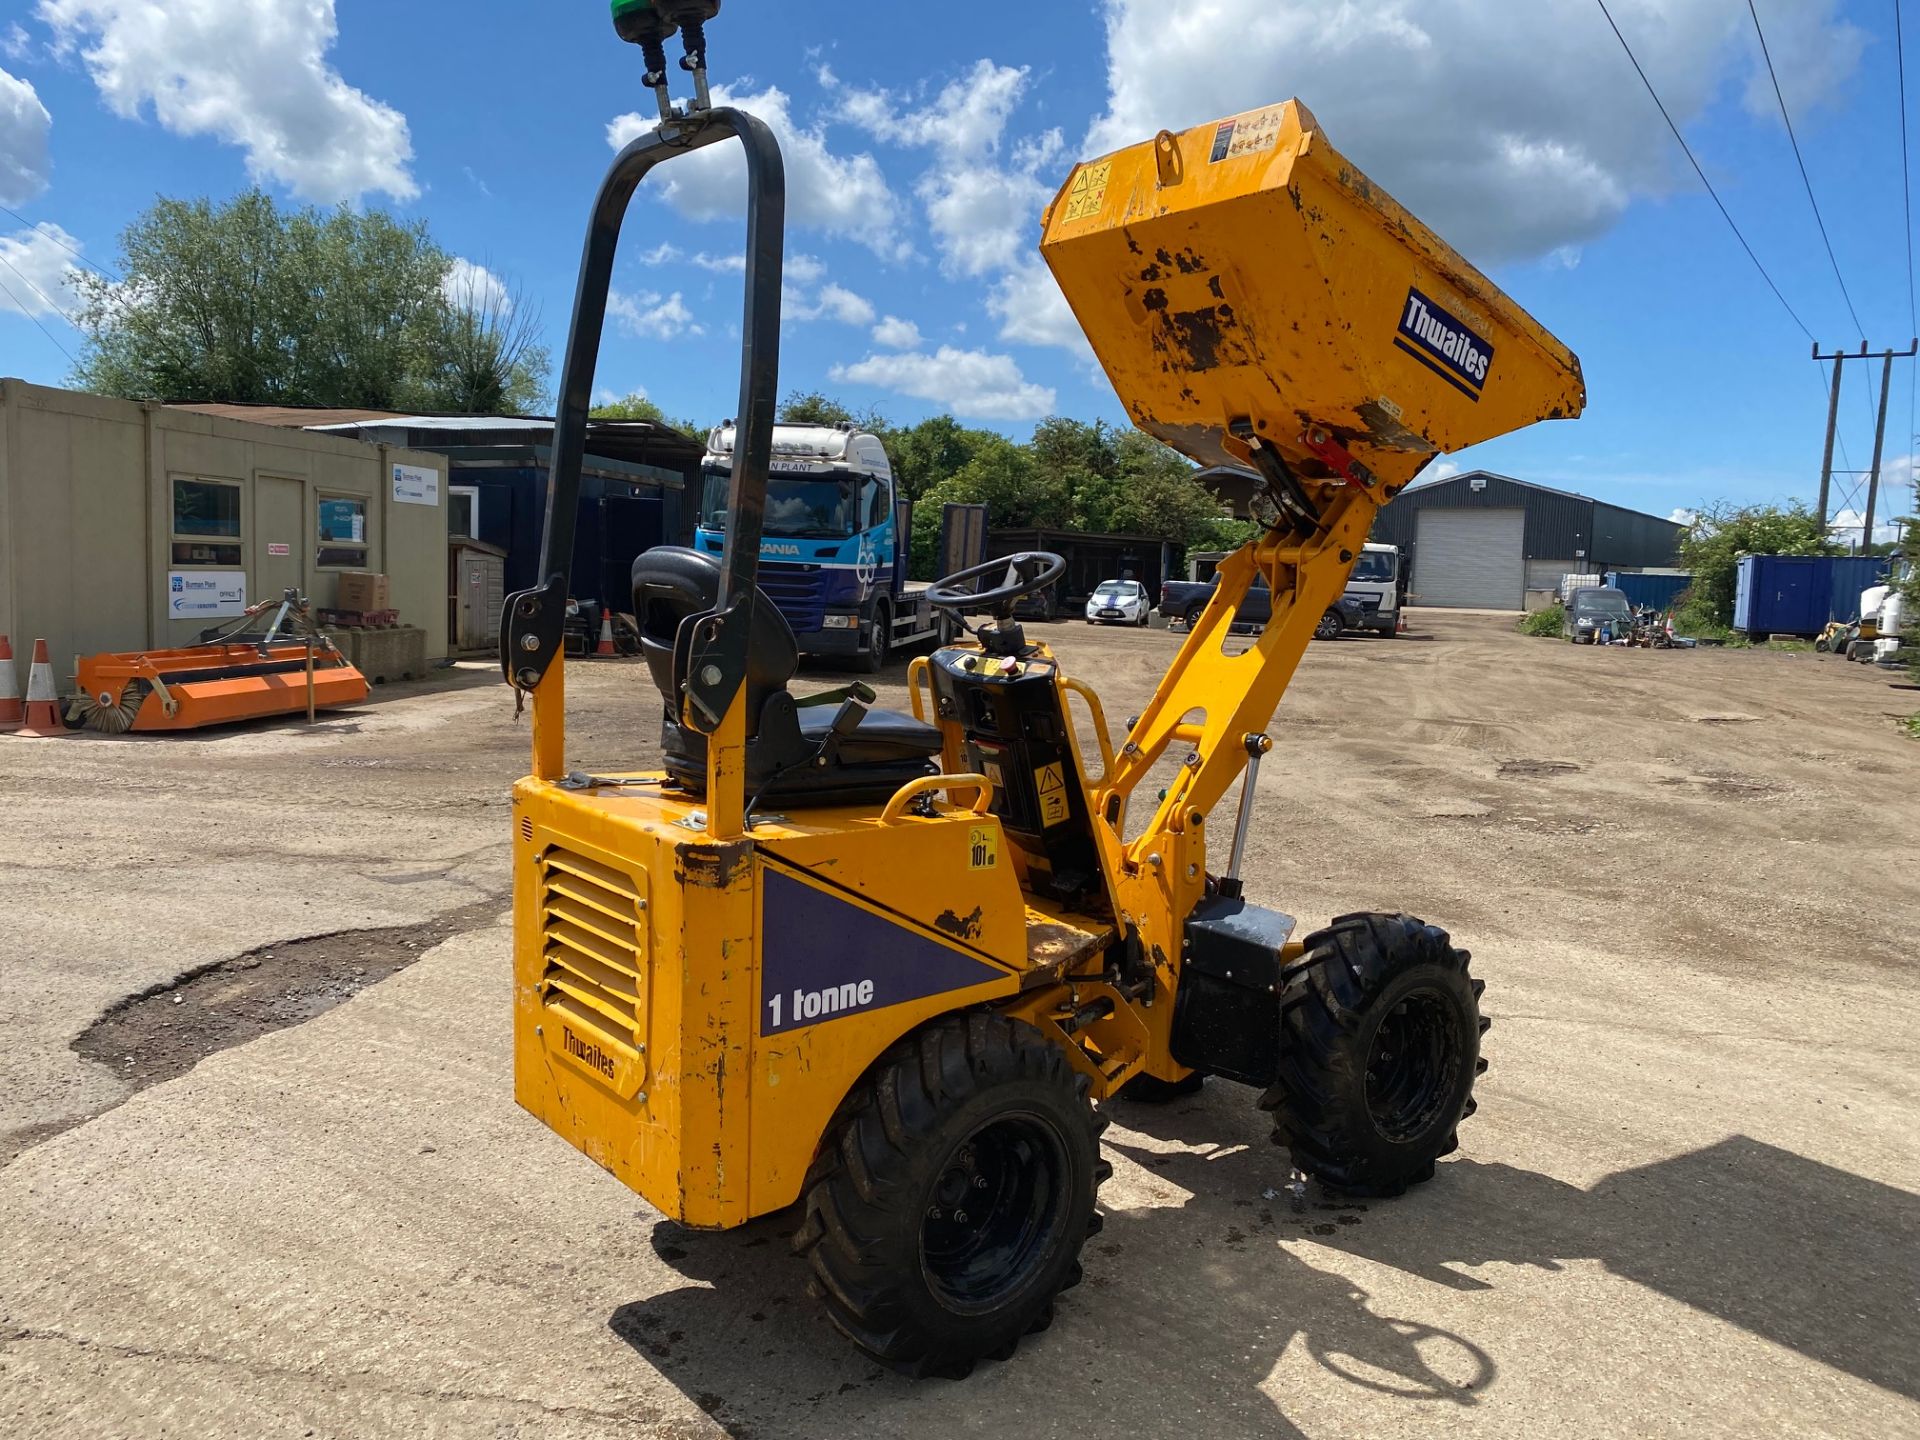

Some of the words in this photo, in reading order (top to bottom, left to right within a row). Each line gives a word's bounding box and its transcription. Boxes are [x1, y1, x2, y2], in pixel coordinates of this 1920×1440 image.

[1405, 295, 1488, 380] Thwaites
[781, 462, 813, 471] PLANT
[971, 845, 987, 867] 101
[769, 993, 781, 1027] 1
[793, 979, 874, 1021] tonne
[563, 1025, 614, 1080] Thwaites
